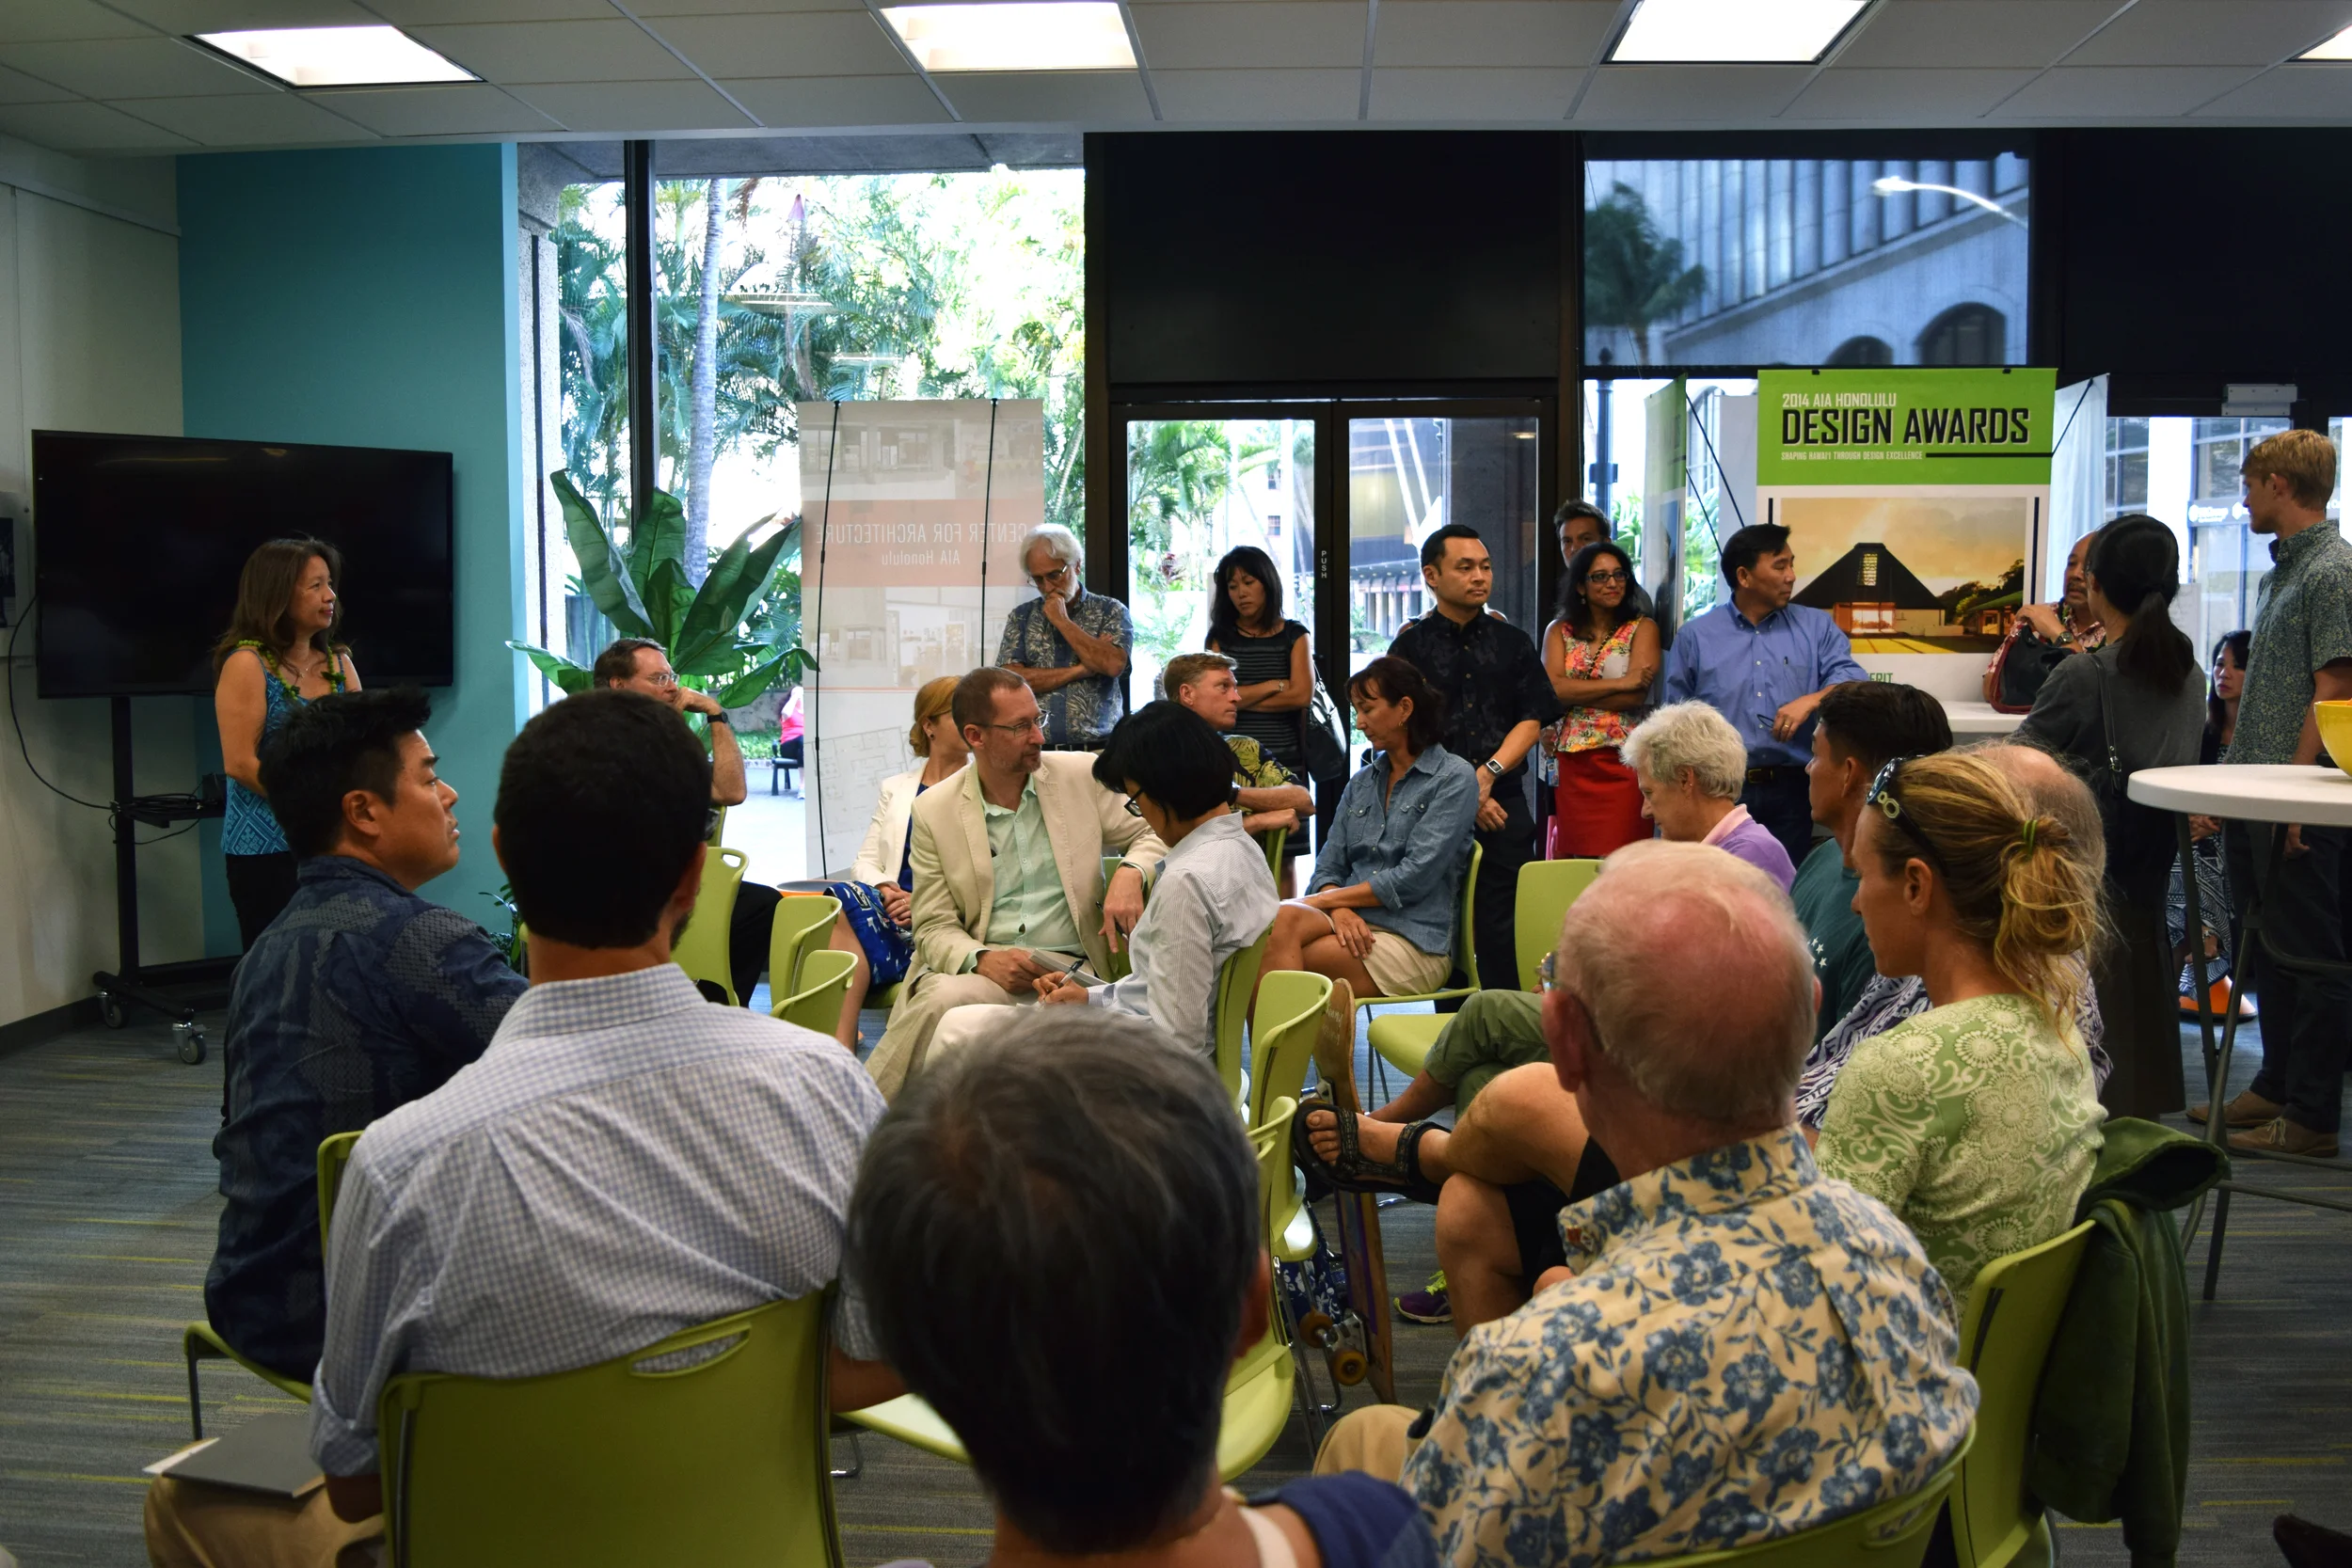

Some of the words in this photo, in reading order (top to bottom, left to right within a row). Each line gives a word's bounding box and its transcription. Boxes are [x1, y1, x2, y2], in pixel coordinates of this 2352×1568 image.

[1782, 392, 1809, 407] 2014
[1813, 392, 1832, 407] AIA
[1836, 392, 1897, 407] HONOLULU
[1782, 408, 1893, 446] DESIGN
[1903, 407, 2030, 445] AWARDS
[1781, 451, 1807, 460] SHAPING
[1834, 451, 1861, 460] THROUGH
[1863, 451, 1884, 460] DESIGN
[1886, 451, 1922, 460] EXCELLENCE
[1867, 673, 1893, 683] ERIT
